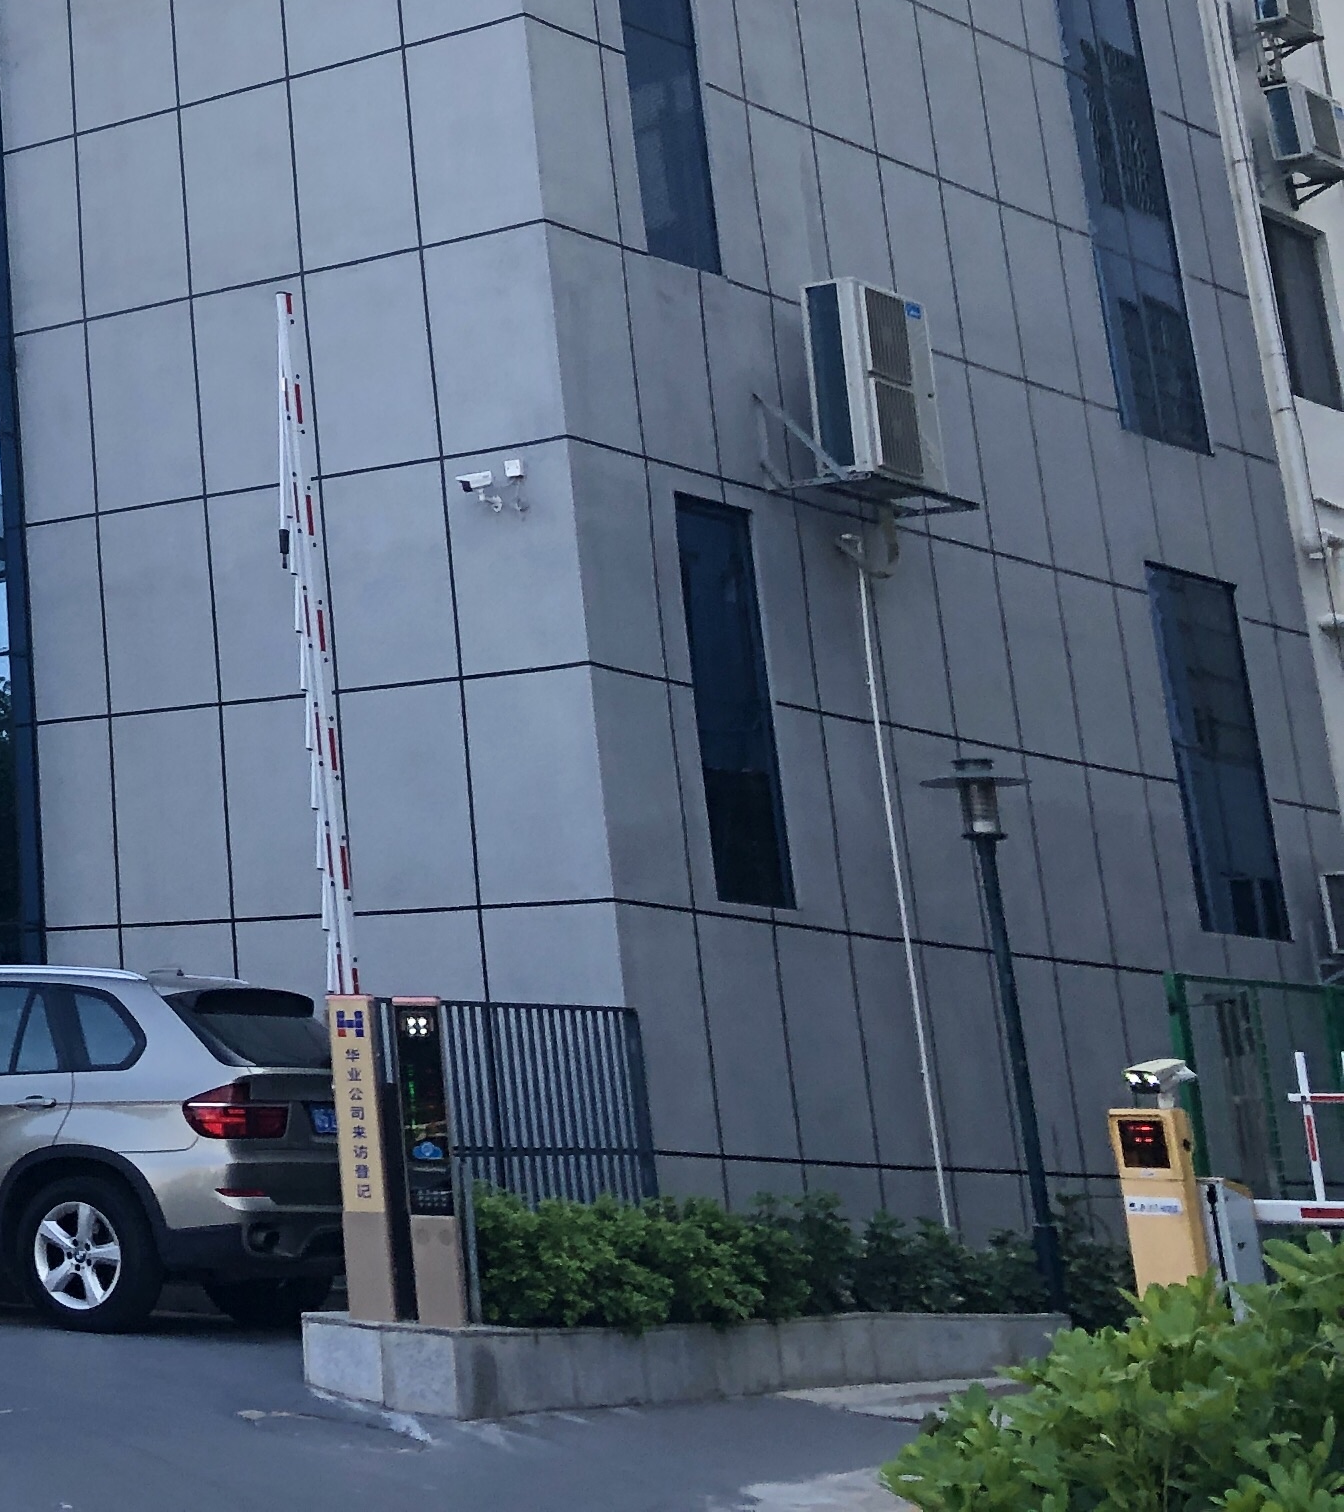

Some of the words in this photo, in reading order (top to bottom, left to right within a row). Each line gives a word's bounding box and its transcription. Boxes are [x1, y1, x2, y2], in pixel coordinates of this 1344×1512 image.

[345, 1048, 372, 1199] 华业公司来访登记
